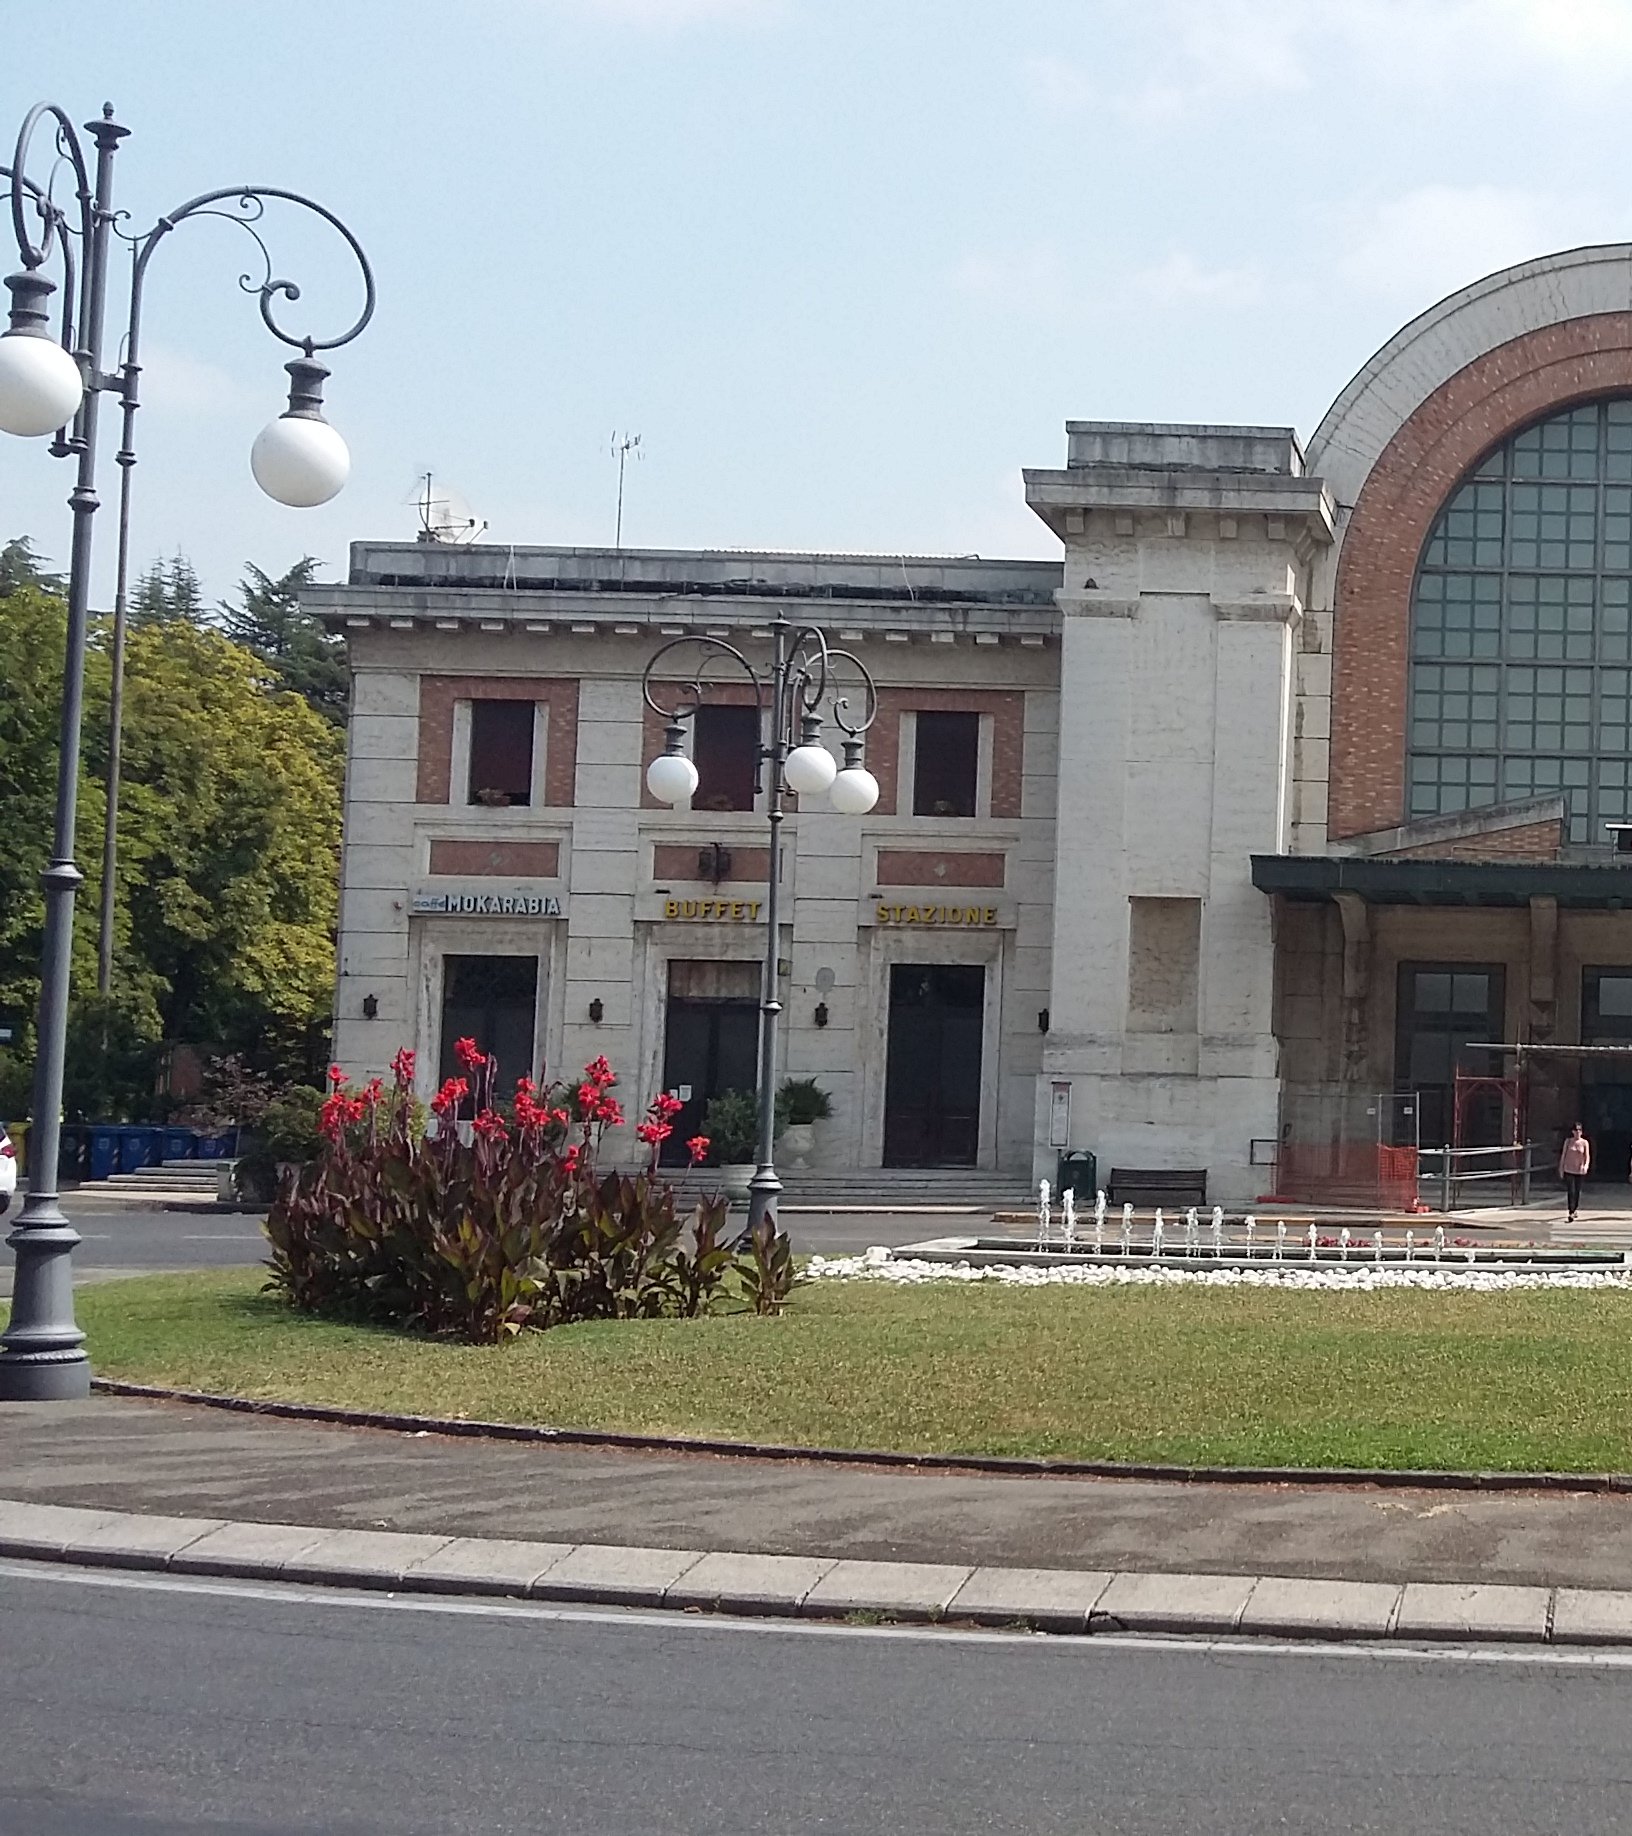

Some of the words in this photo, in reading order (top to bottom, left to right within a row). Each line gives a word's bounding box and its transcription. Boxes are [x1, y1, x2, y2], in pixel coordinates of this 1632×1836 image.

[446, 895, 560, 915] MOKARABIA
[665, 900, 762, 920] BUFFET
[876, 904, 998, 925] STAZIONE
